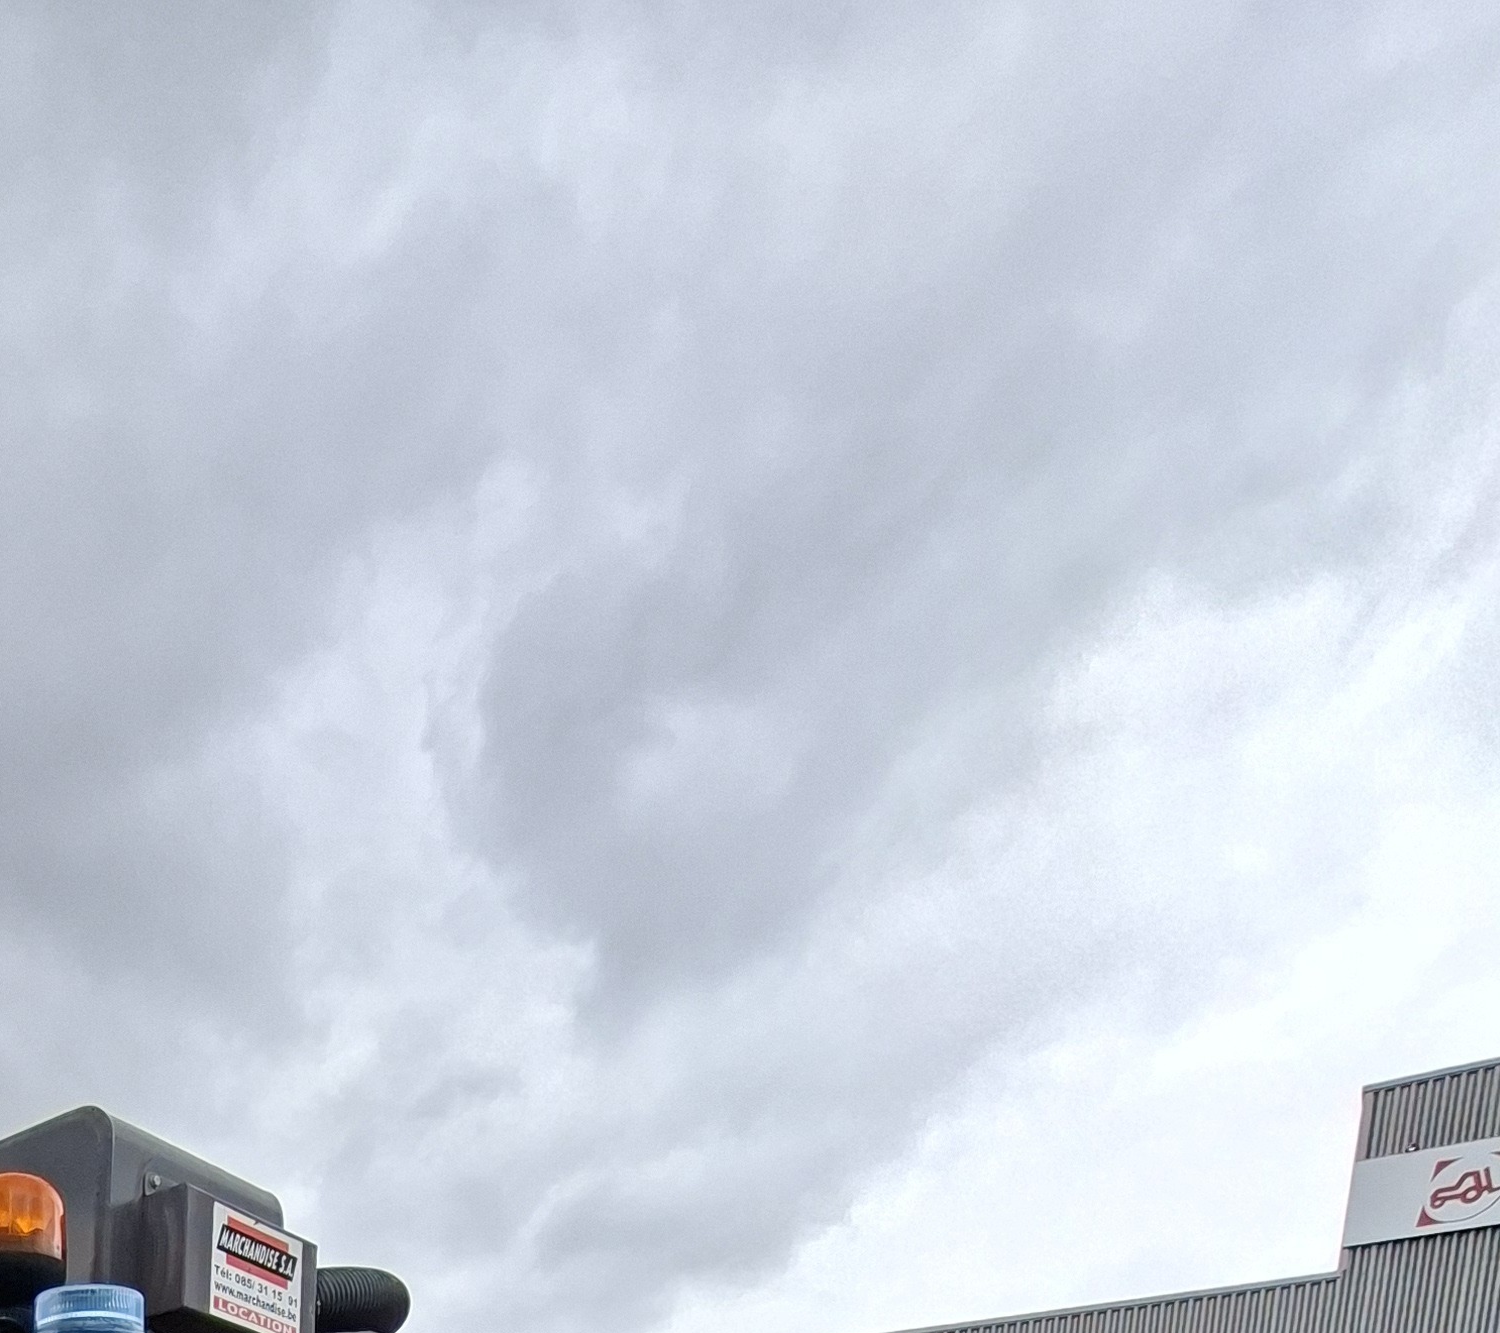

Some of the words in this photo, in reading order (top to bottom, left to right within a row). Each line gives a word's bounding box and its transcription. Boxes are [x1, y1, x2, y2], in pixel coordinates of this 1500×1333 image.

[219, 1227, 279, 1272] MARCHANDISE
[214, 1264, 232, 1281] Tél:
[257, 1282, 269, 1296] 31
[272, 1289, 283, 1302] 15
[287, 1295, 298, 1308] 91
[214, 1281, 297, 1322] www.marchandise.be
